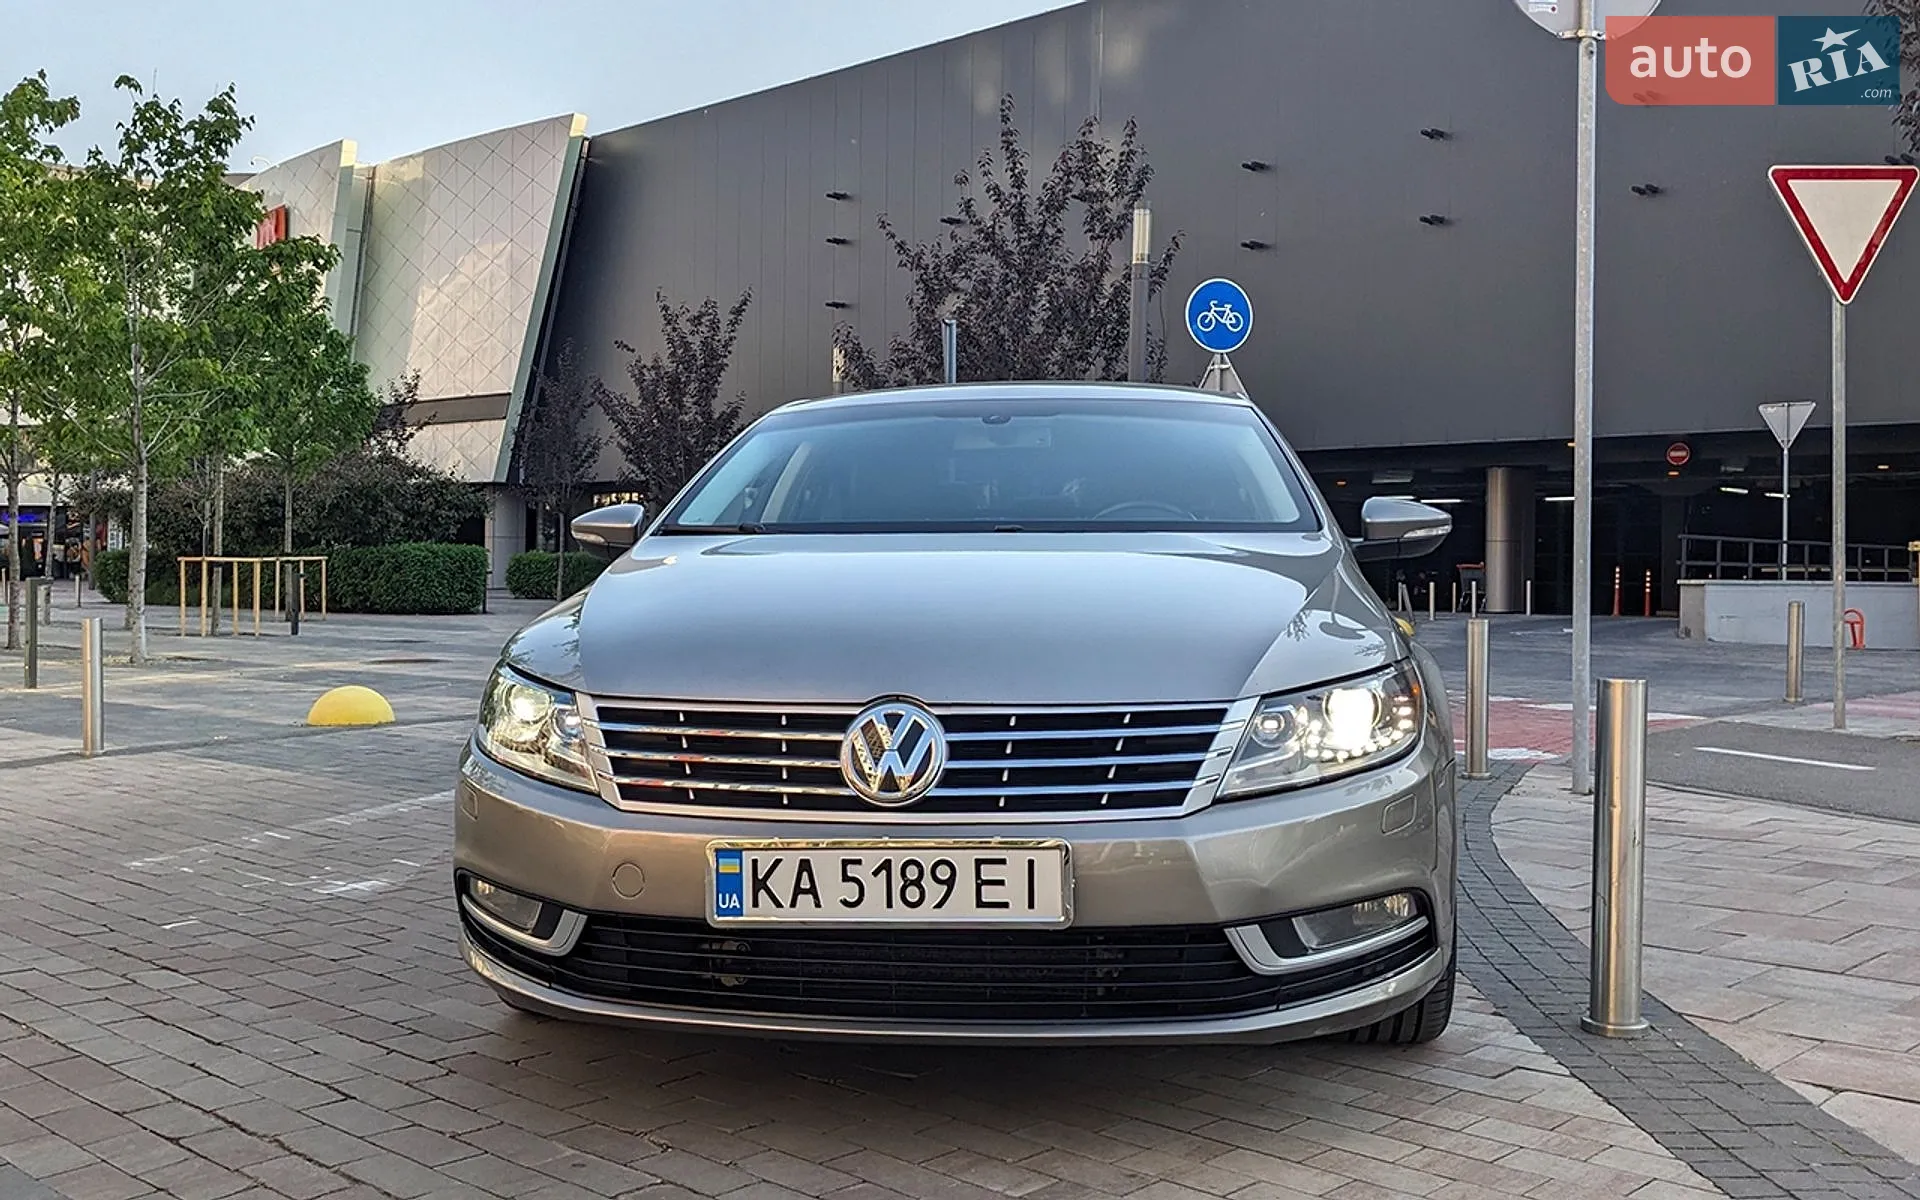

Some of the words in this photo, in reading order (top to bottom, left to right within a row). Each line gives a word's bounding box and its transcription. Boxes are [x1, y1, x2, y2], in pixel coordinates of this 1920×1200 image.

[751, 858, 822, 909] KA
[838, 857, 958, 909] 5189
[974, 858, 1036, 909] EI
[718, 893, 741, 909] UA
